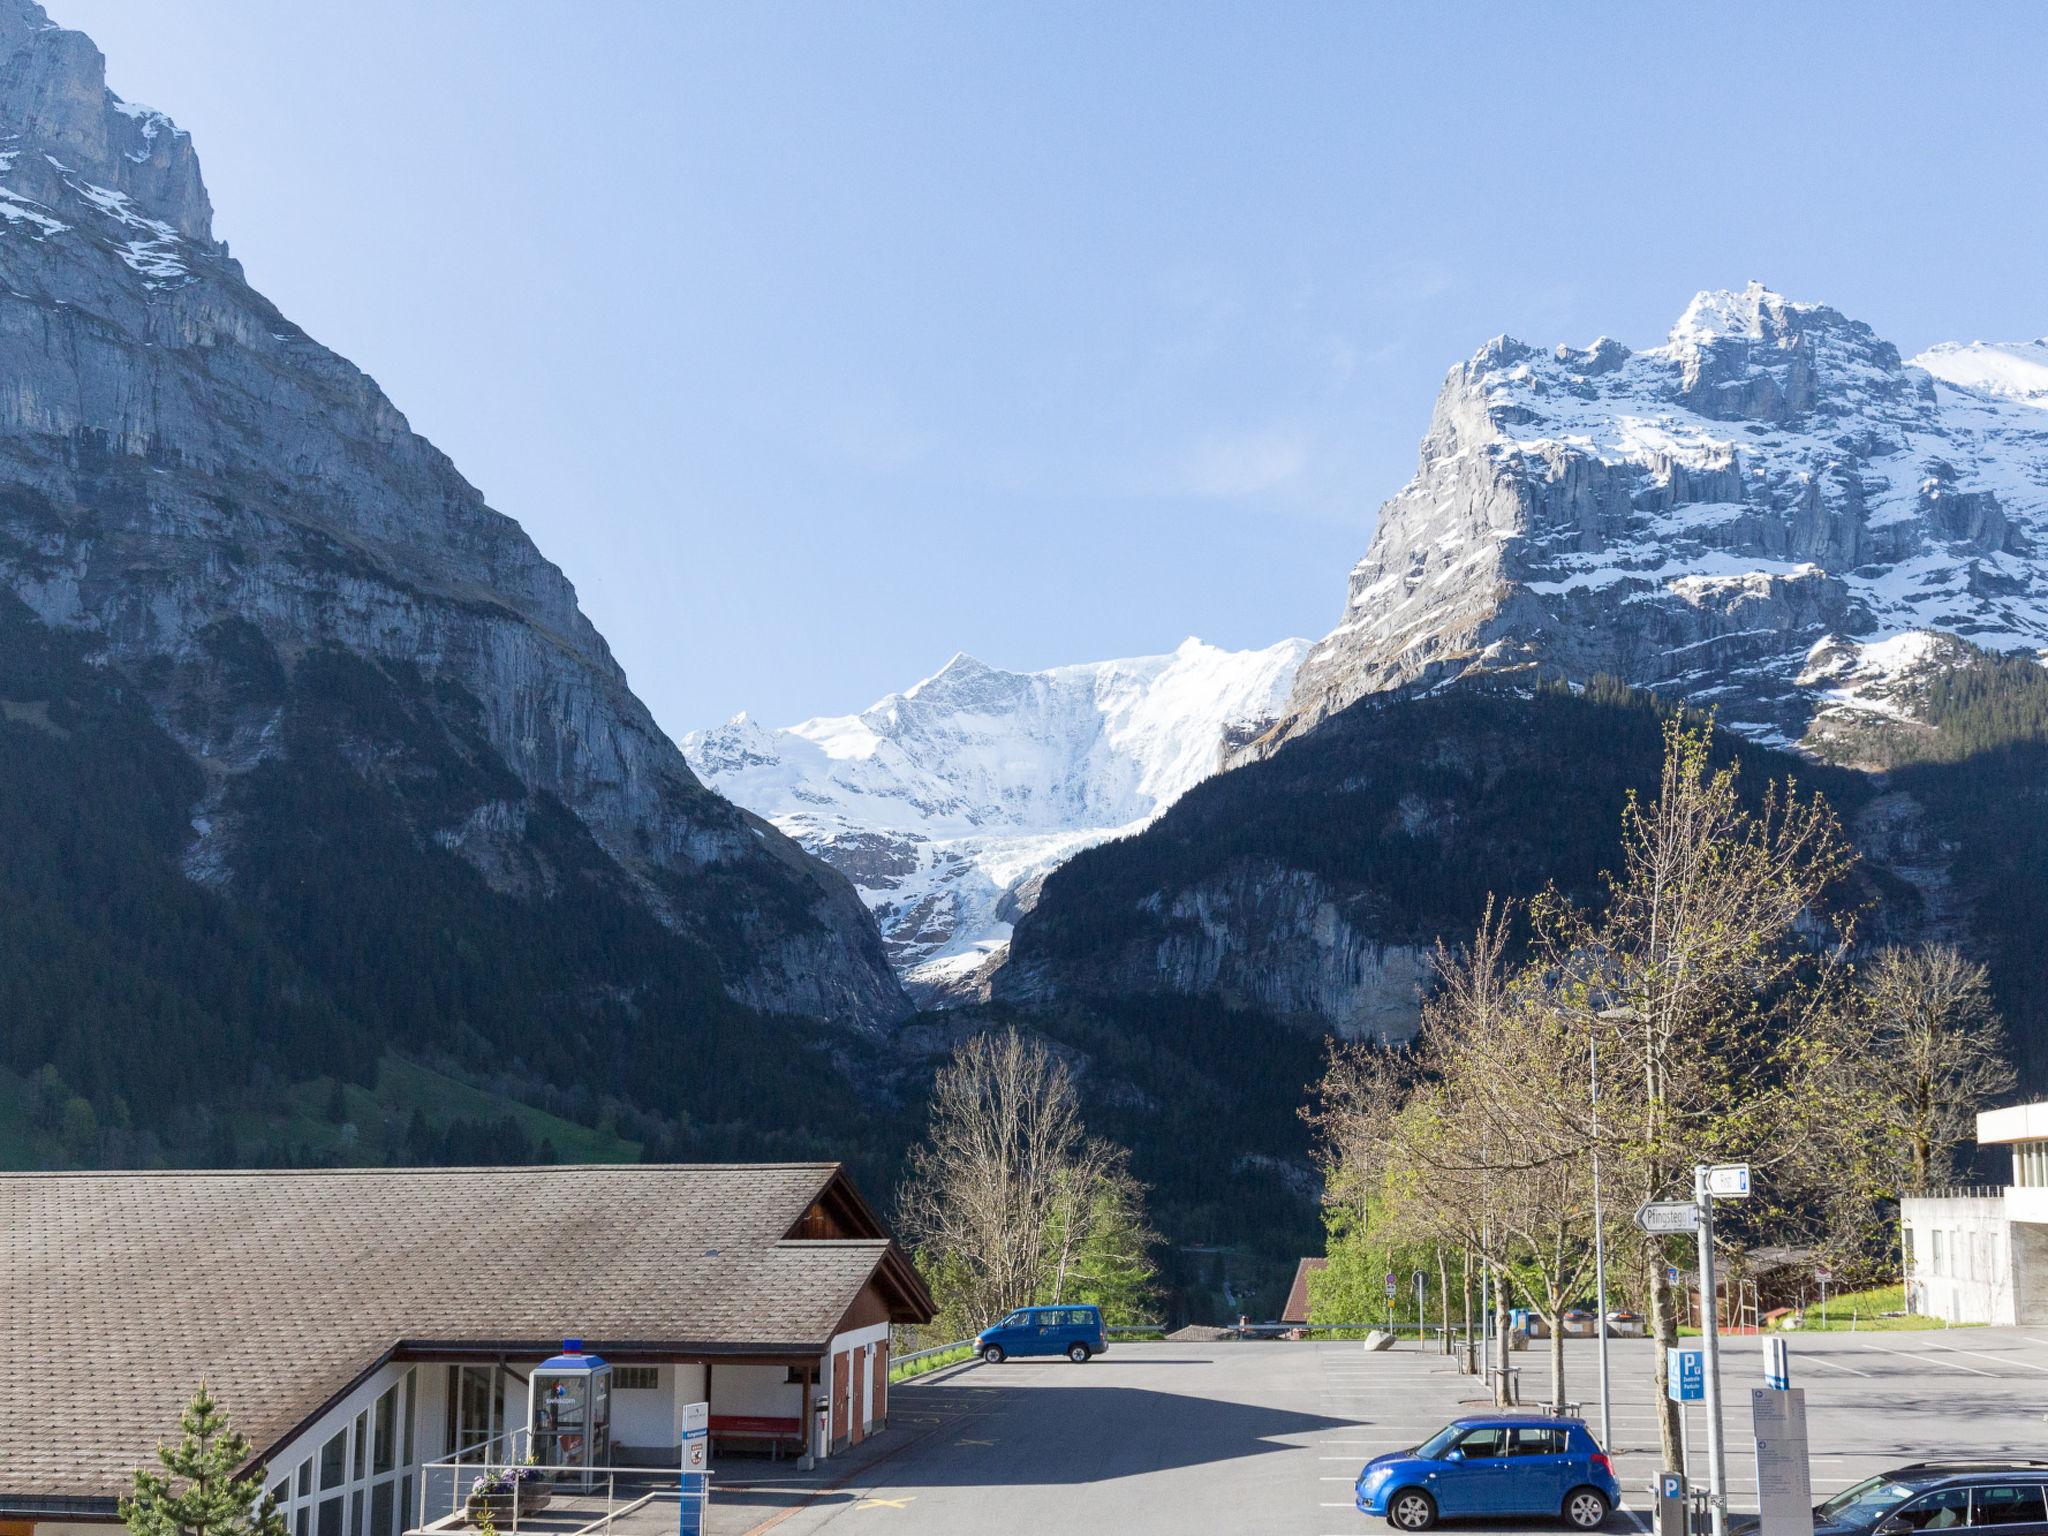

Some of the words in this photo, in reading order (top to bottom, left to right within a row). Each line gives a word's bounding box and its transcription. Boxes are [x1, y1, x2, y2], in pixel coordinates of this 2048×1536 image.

[1647, 1208, 1687, 1227] Pfingstegg
[1684, 1354, 1695, 1376] P
[1666, 1479, 1678, 1497] P
